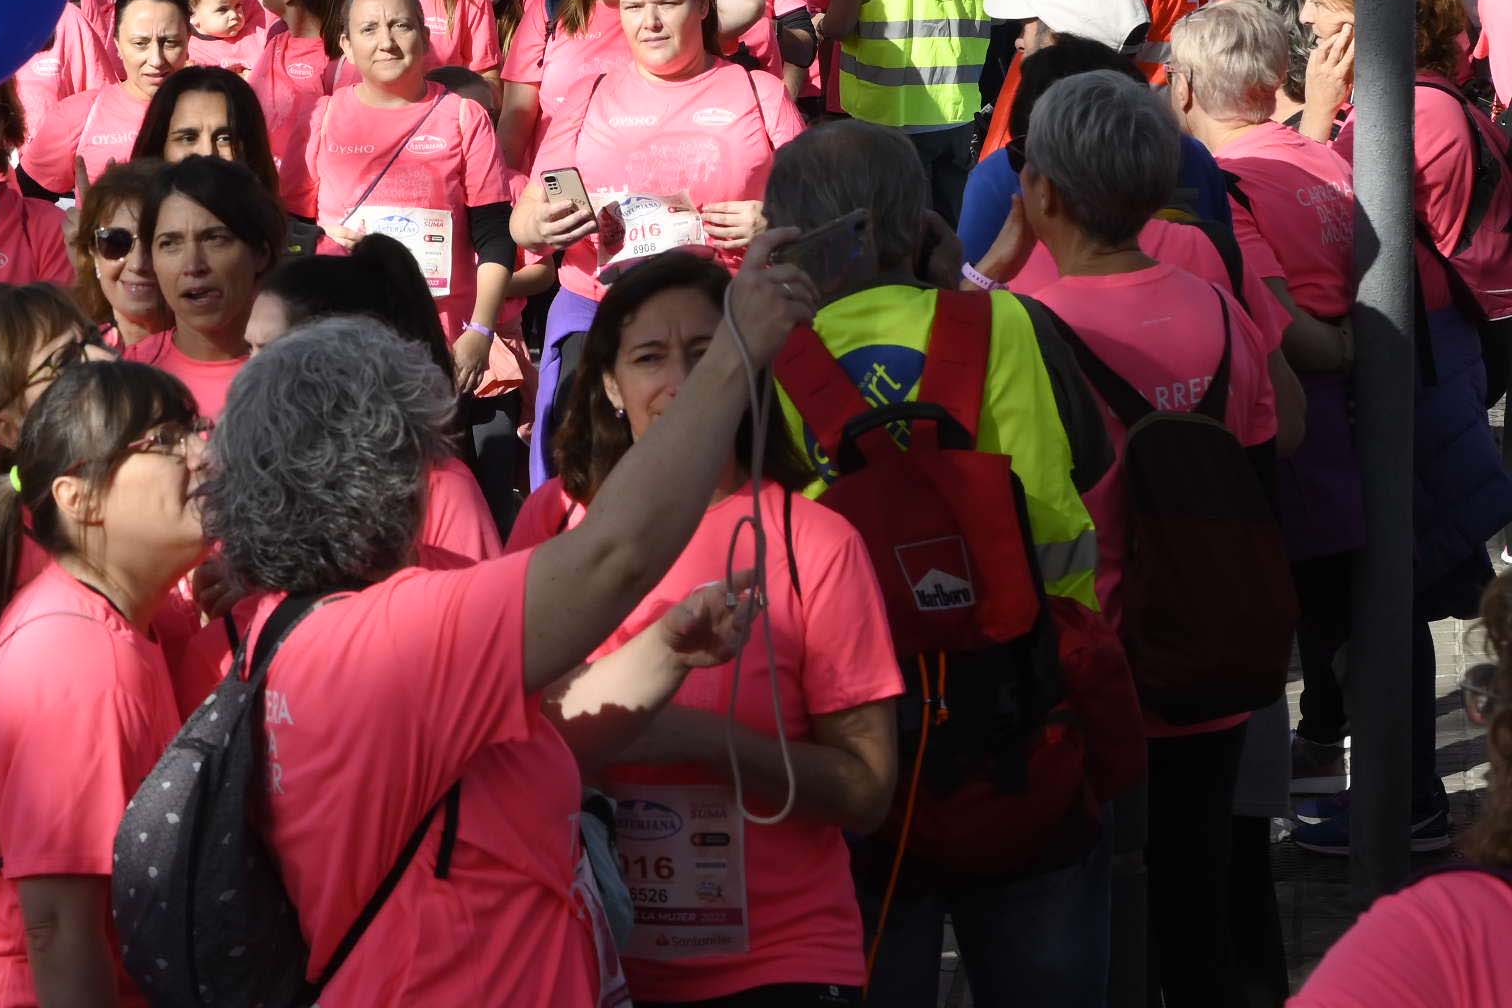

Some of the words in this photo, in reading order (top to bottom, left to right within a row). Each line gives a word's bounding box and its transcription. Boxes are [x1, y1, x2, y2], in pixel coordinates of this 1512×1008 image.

[328, 143, 375, 154] OYSHO
[629, 223, 662, 242] 016
[916, 584, 972, 608] Marlboro
[671, 935, 734, 946] Santander
